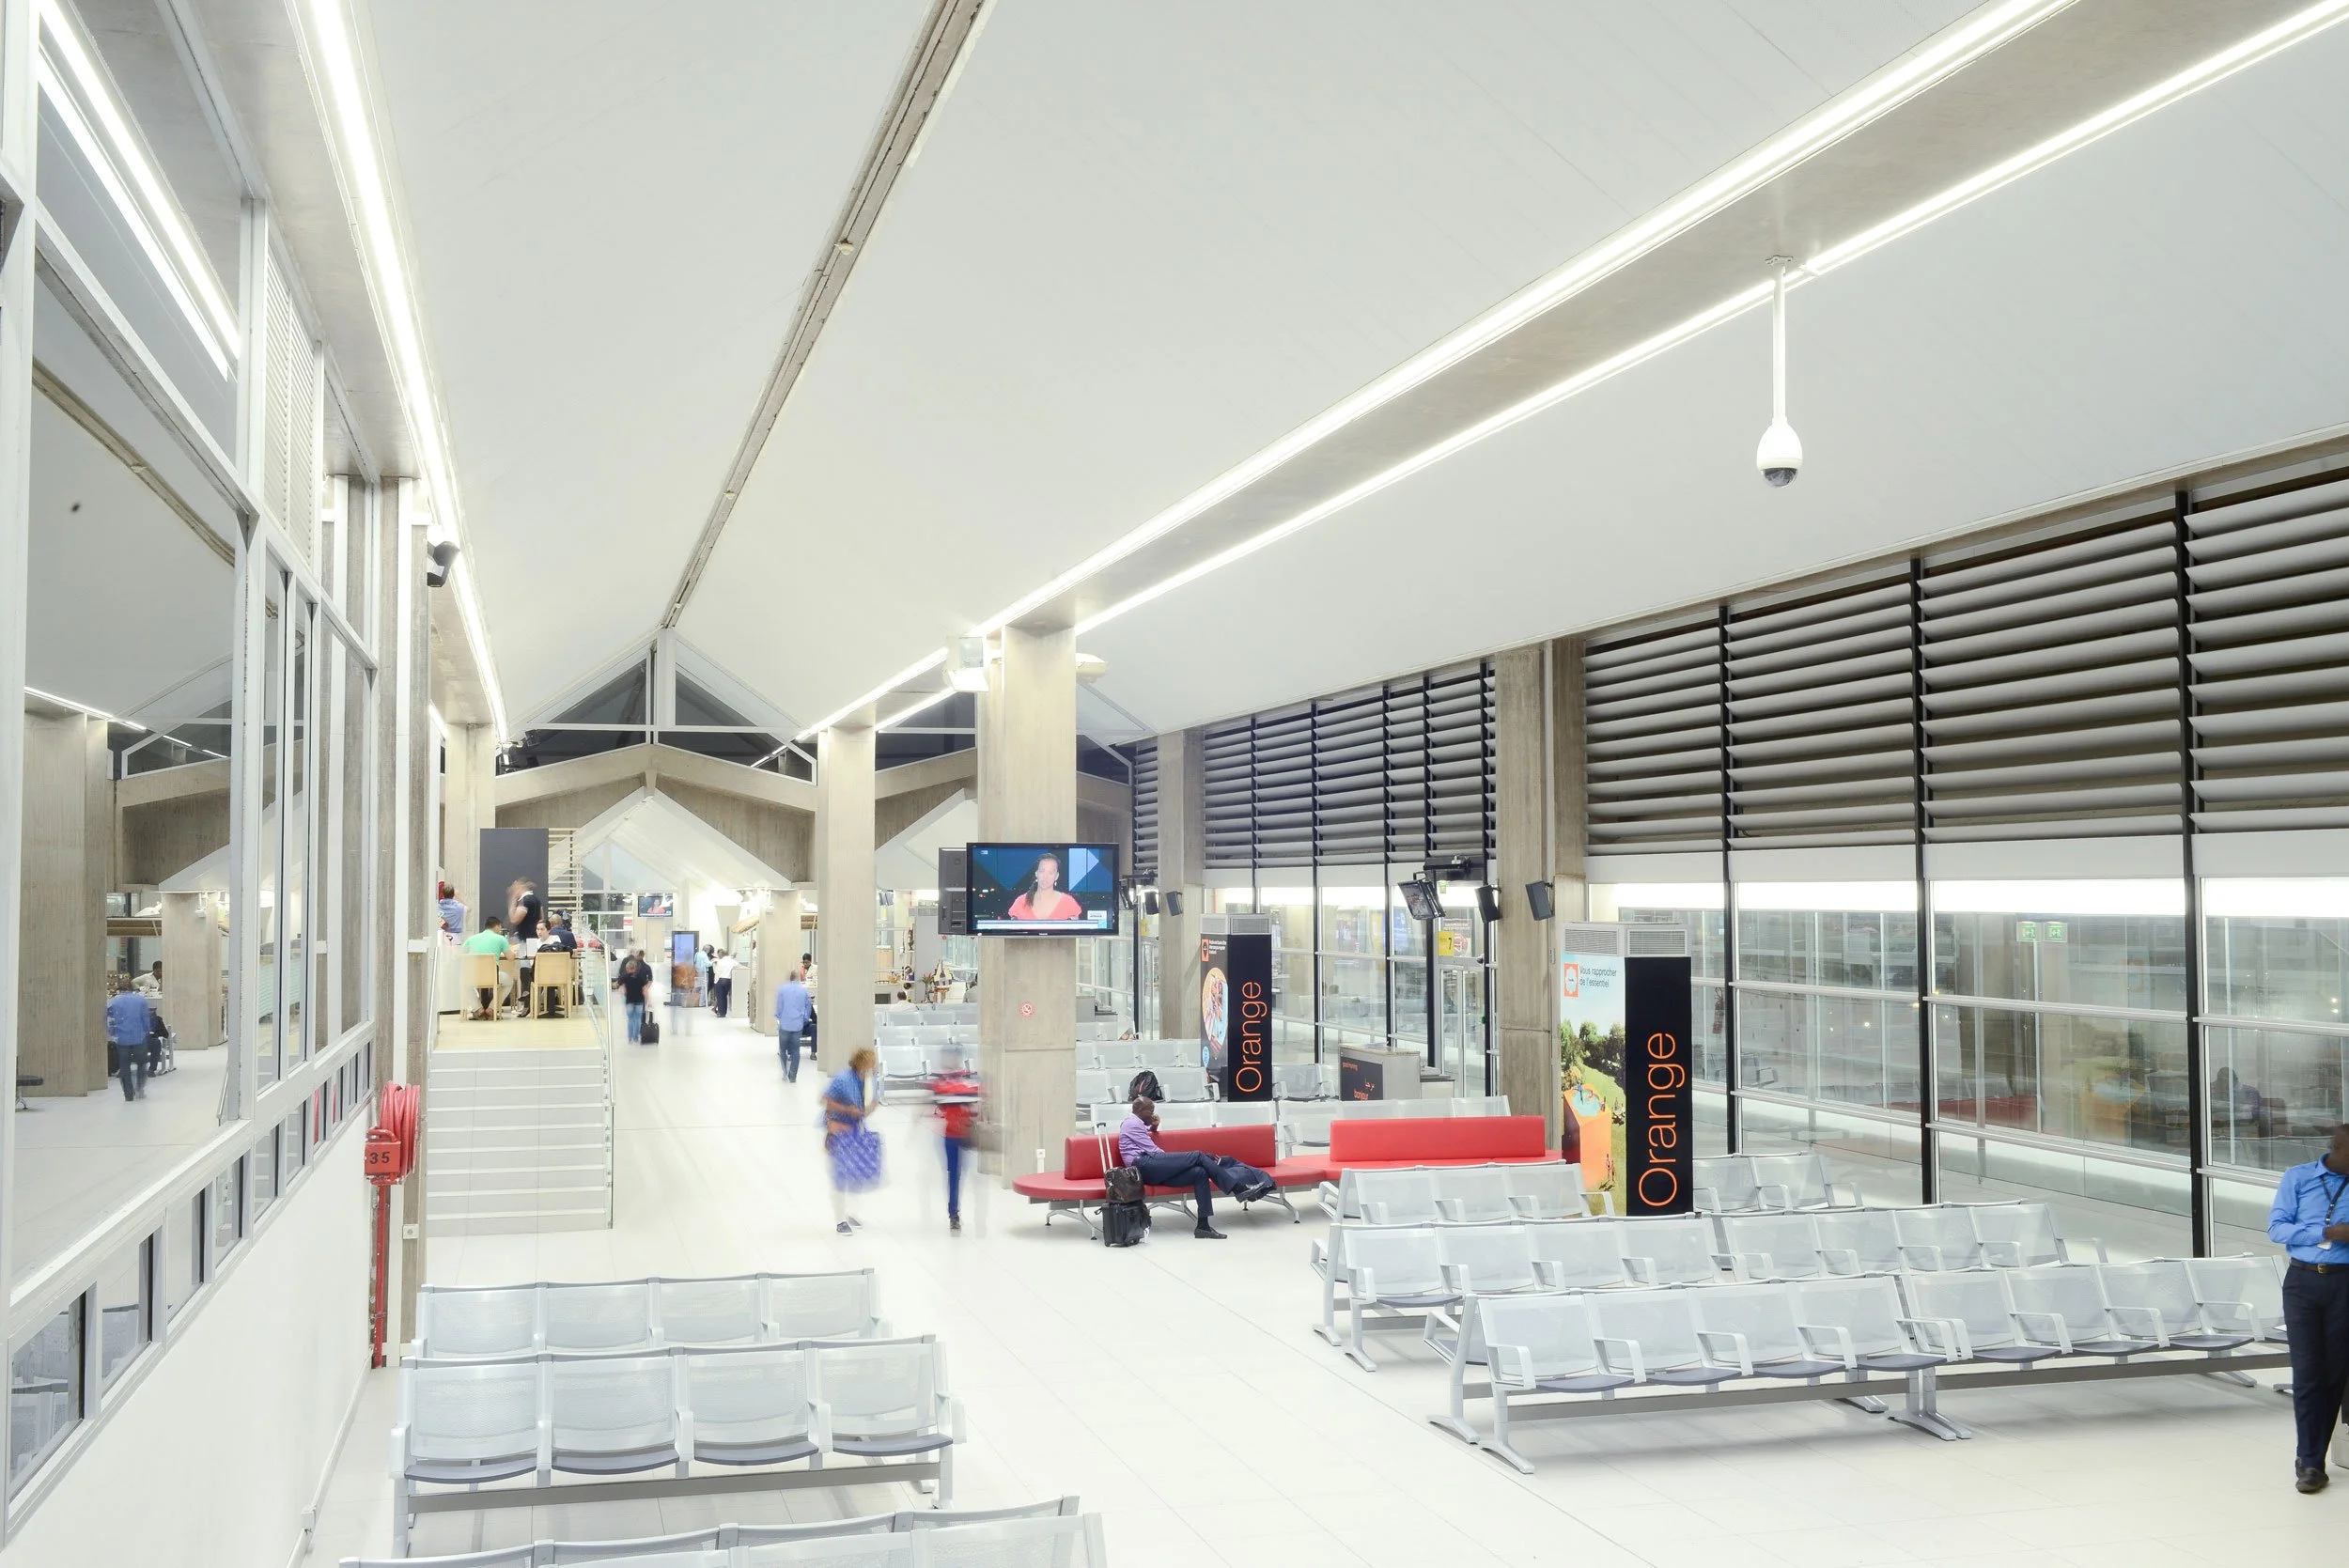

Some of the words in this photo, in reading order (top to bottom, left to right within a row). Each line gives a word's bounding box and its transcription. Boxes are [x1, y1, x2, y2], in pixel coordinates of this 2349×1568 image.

[1579, 967, 1591, 975] Vous
[1592, 968, 1617, 977] rapprocher
[1579, 978, 1586, 986] de
[1237, 982, 1268, 1092] Orange
[1639, 1033, 1686, 1206] Orange
